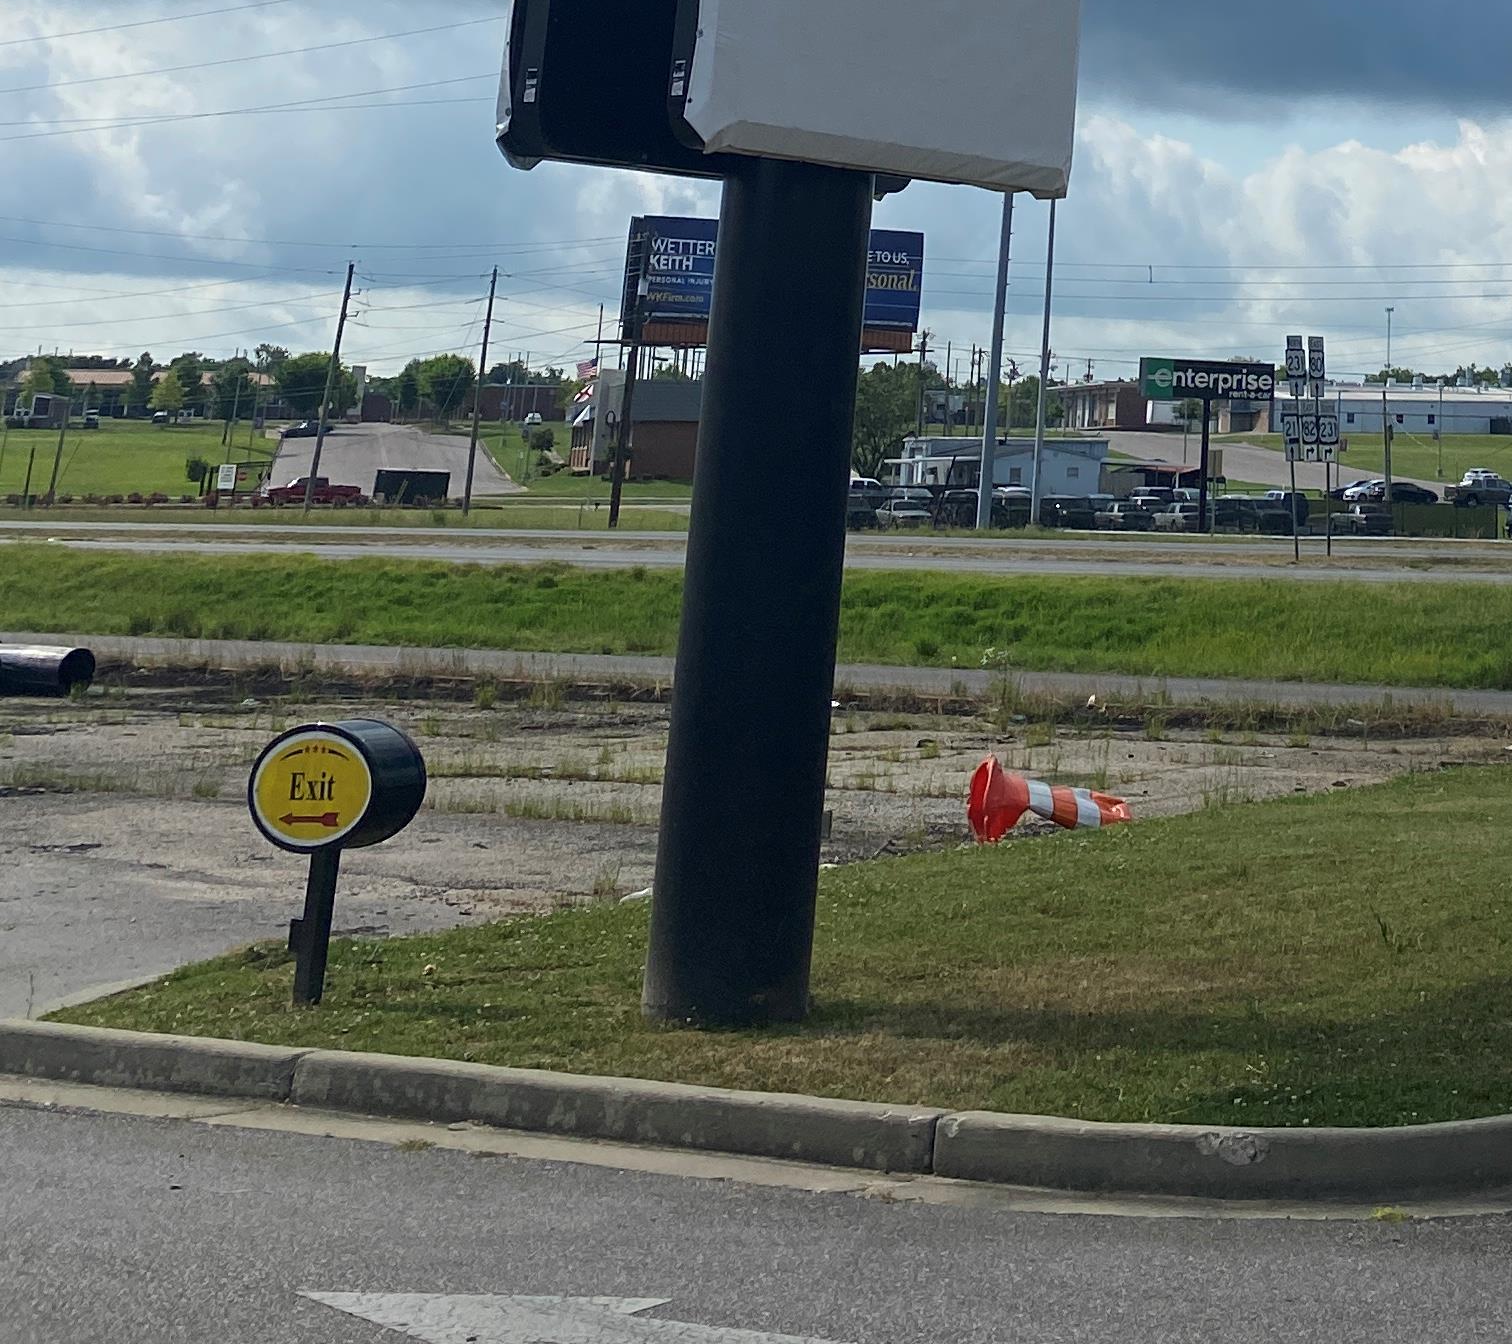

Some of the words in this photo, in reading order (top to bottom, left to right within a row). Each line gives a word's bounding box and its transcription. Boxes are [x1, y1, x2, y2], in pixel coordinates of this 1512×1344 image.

[650, 254, 693, 271] KEITH
[875, 251, 891, 263] TO
[866, 269, 917, 291] sonal.
[1310, 356, 1323, 372] 80
[1148, 368, 1273, 394] enterprise
[1285, 420, 1297, 437] 21
[1303, 421, 1316, 436] 82
[1320, 421, 1337, 437] 231
[289, 771, 336, 801] Exit
